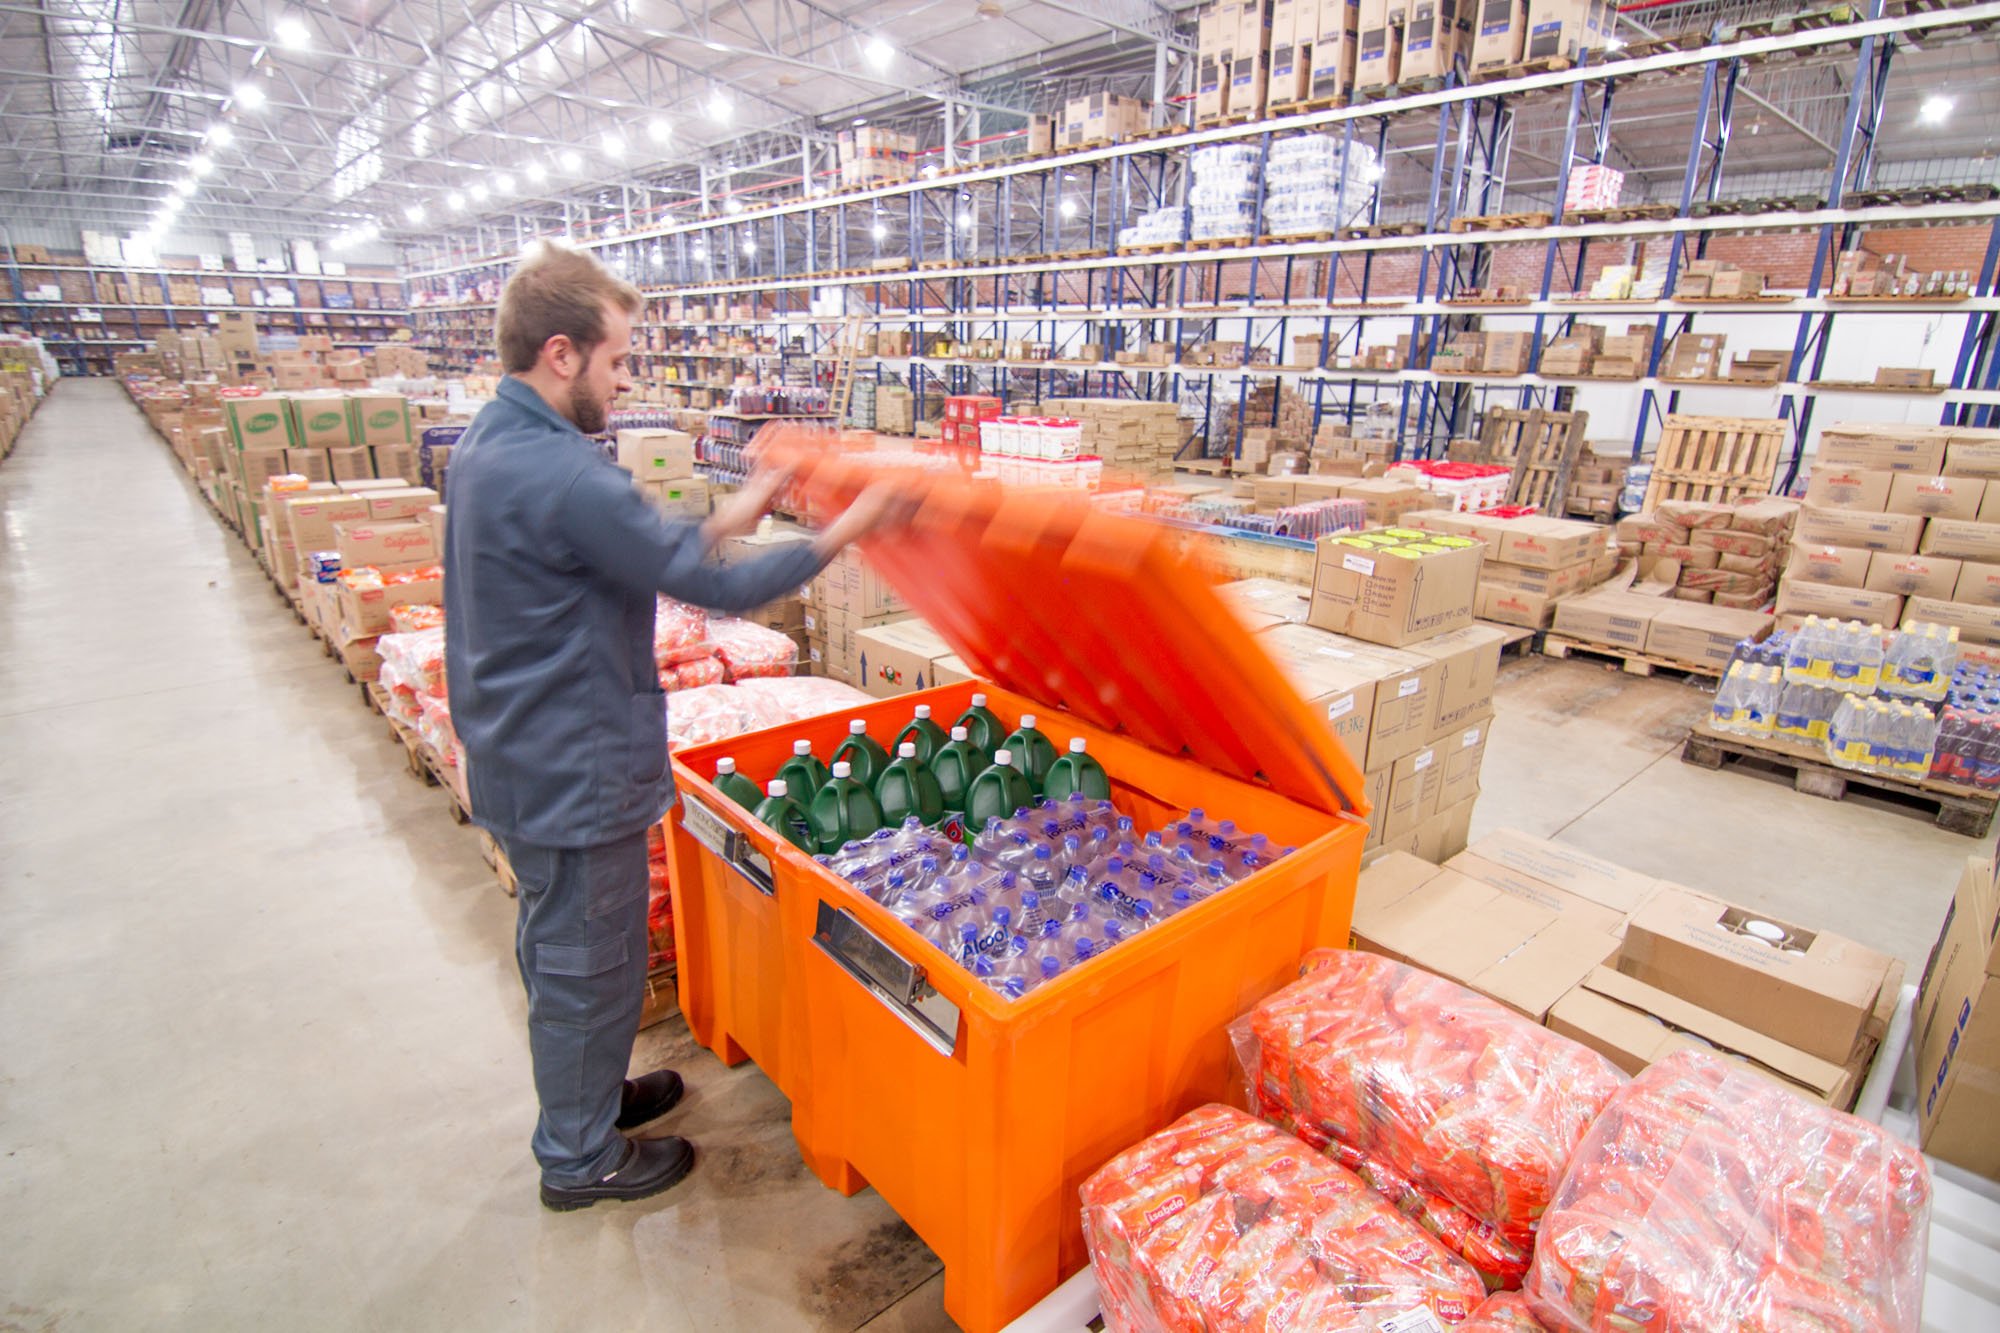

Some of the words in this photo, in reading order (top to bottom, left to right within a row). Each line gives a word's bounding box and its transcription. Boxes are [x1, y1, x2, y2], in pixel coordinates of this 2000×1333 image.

[890, 843, 933, 867] Alcool
[962, 925, 1009, 959] Alcool
[1150, 1197, 1185, 1223] isabela
[1439, 1301, 1463, 1315] isab
